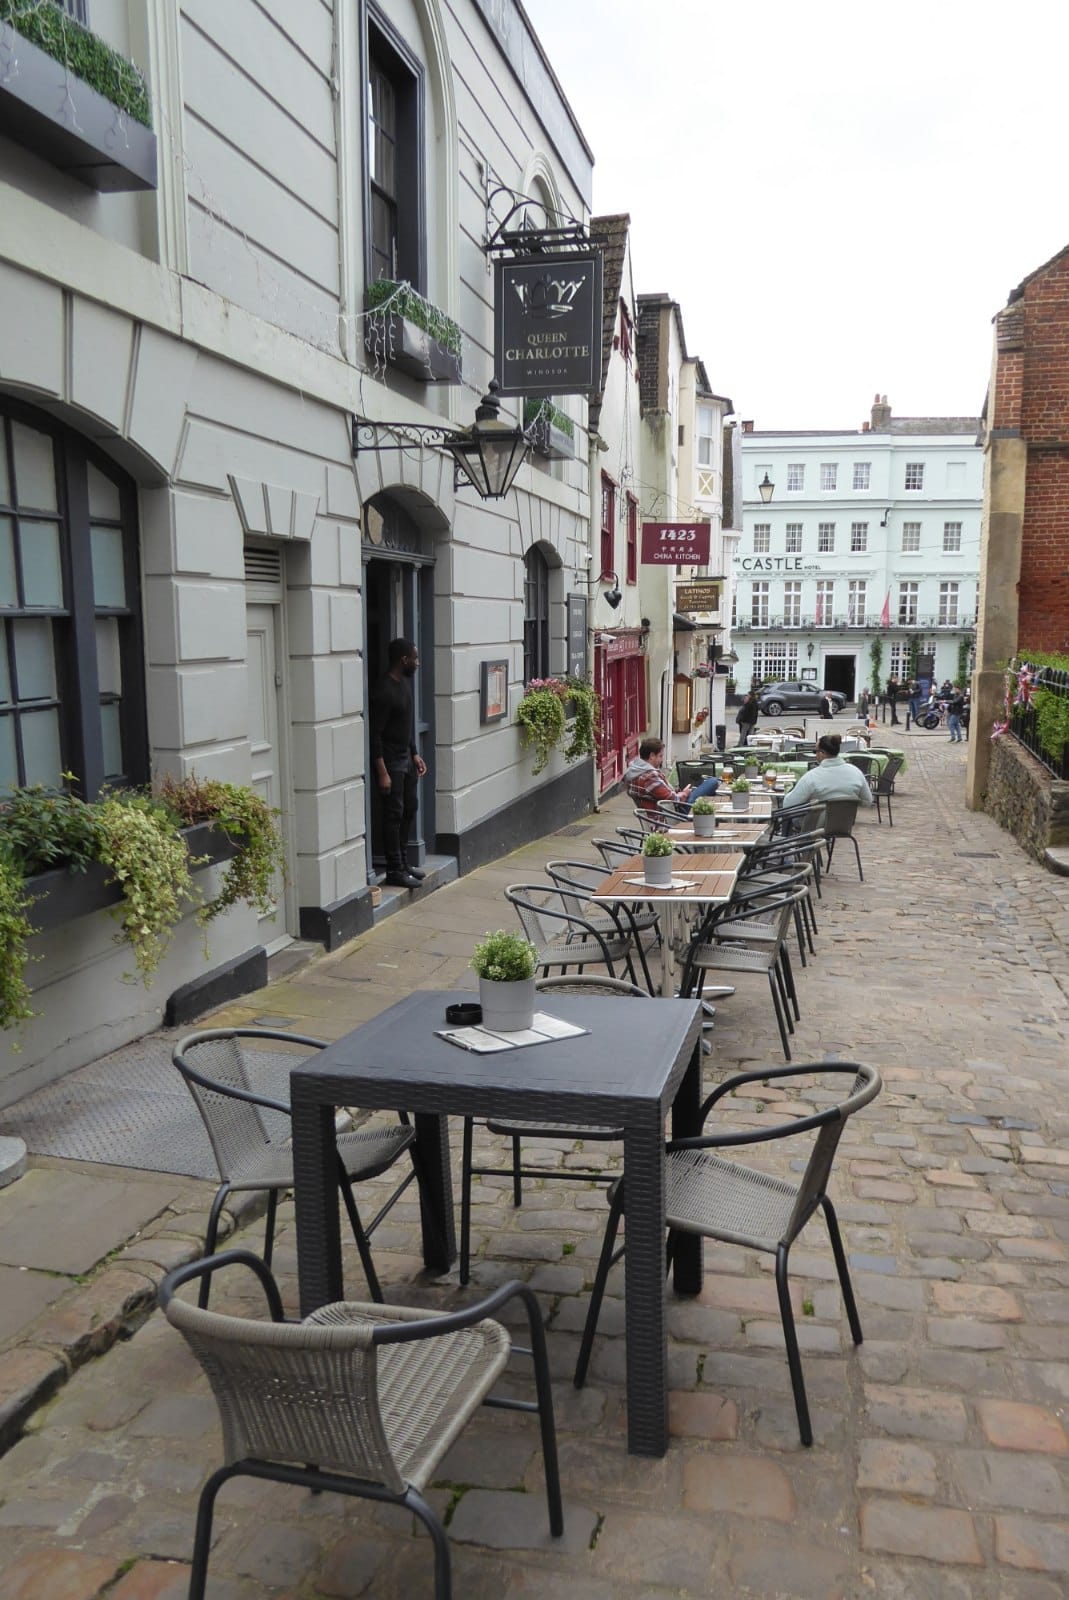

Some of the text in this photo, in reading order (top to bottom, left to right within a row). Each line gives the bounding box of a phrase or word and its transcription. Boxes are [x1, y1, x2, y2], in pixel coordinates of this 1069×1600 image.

[527, 332, 567, 346] QUEEN
[505, 345, 590, 361] CHARLOTTE
[526, 368, 568, 376] WINDSOR
[659, 529, 696, 541] 1423
[742, 557, 803, 571] CASTLE
